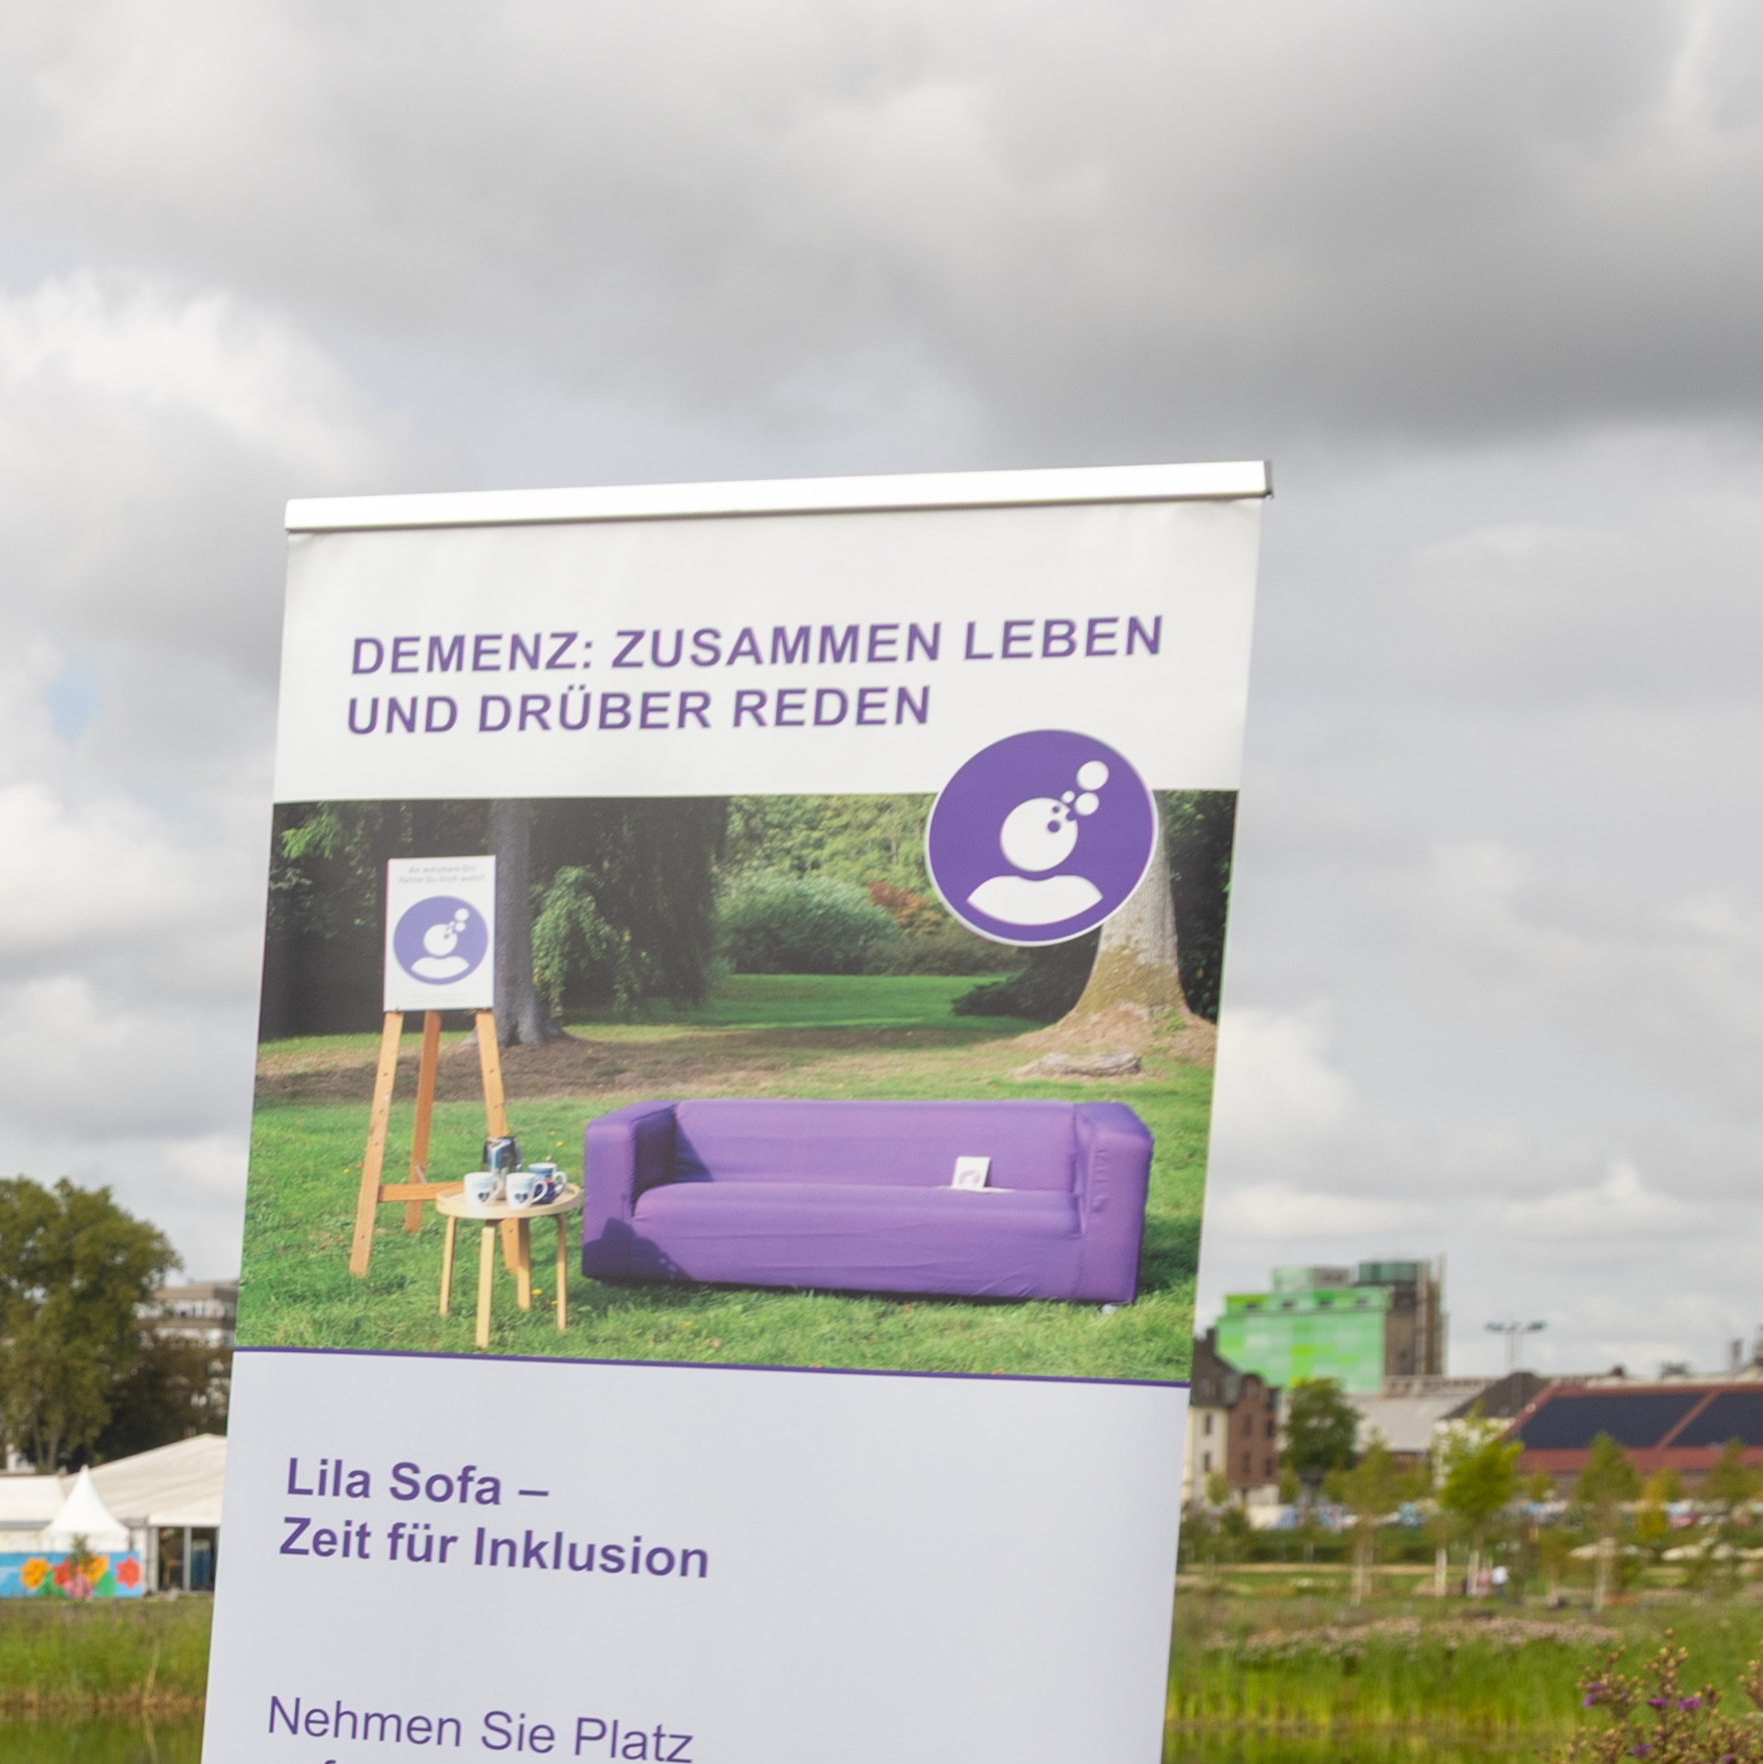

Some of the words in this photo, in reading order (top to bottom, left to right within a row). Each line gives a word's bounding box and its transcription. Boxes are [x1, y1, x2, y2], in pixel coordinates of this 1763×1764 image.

[351, 631, 593, 675] DEMENZ:
[611, 622, 941, 669] ZUSAMMEN
[964, 615, 1162, 660] LEBEN
[347, 695, 458, 735] UND
[478, 684, 711, 733] DRÜBER
[733, 685, 930, 728] REDEN
[287, 1457, 371, 1499] Lila
[389, 1461, 501, 1506] Sofa
[518, 1489, 549, 1497] –
[279, 1516, 372, 1560] Zeit
[387, 1522, 459, 1564] für
[474, 1526, 708, 1578] Inklusion
[268, 1695, 462, 1747] Nehmen
[481, 1710, 555, 1754] Sie
[574, 1716, 693, 1764] Platz
